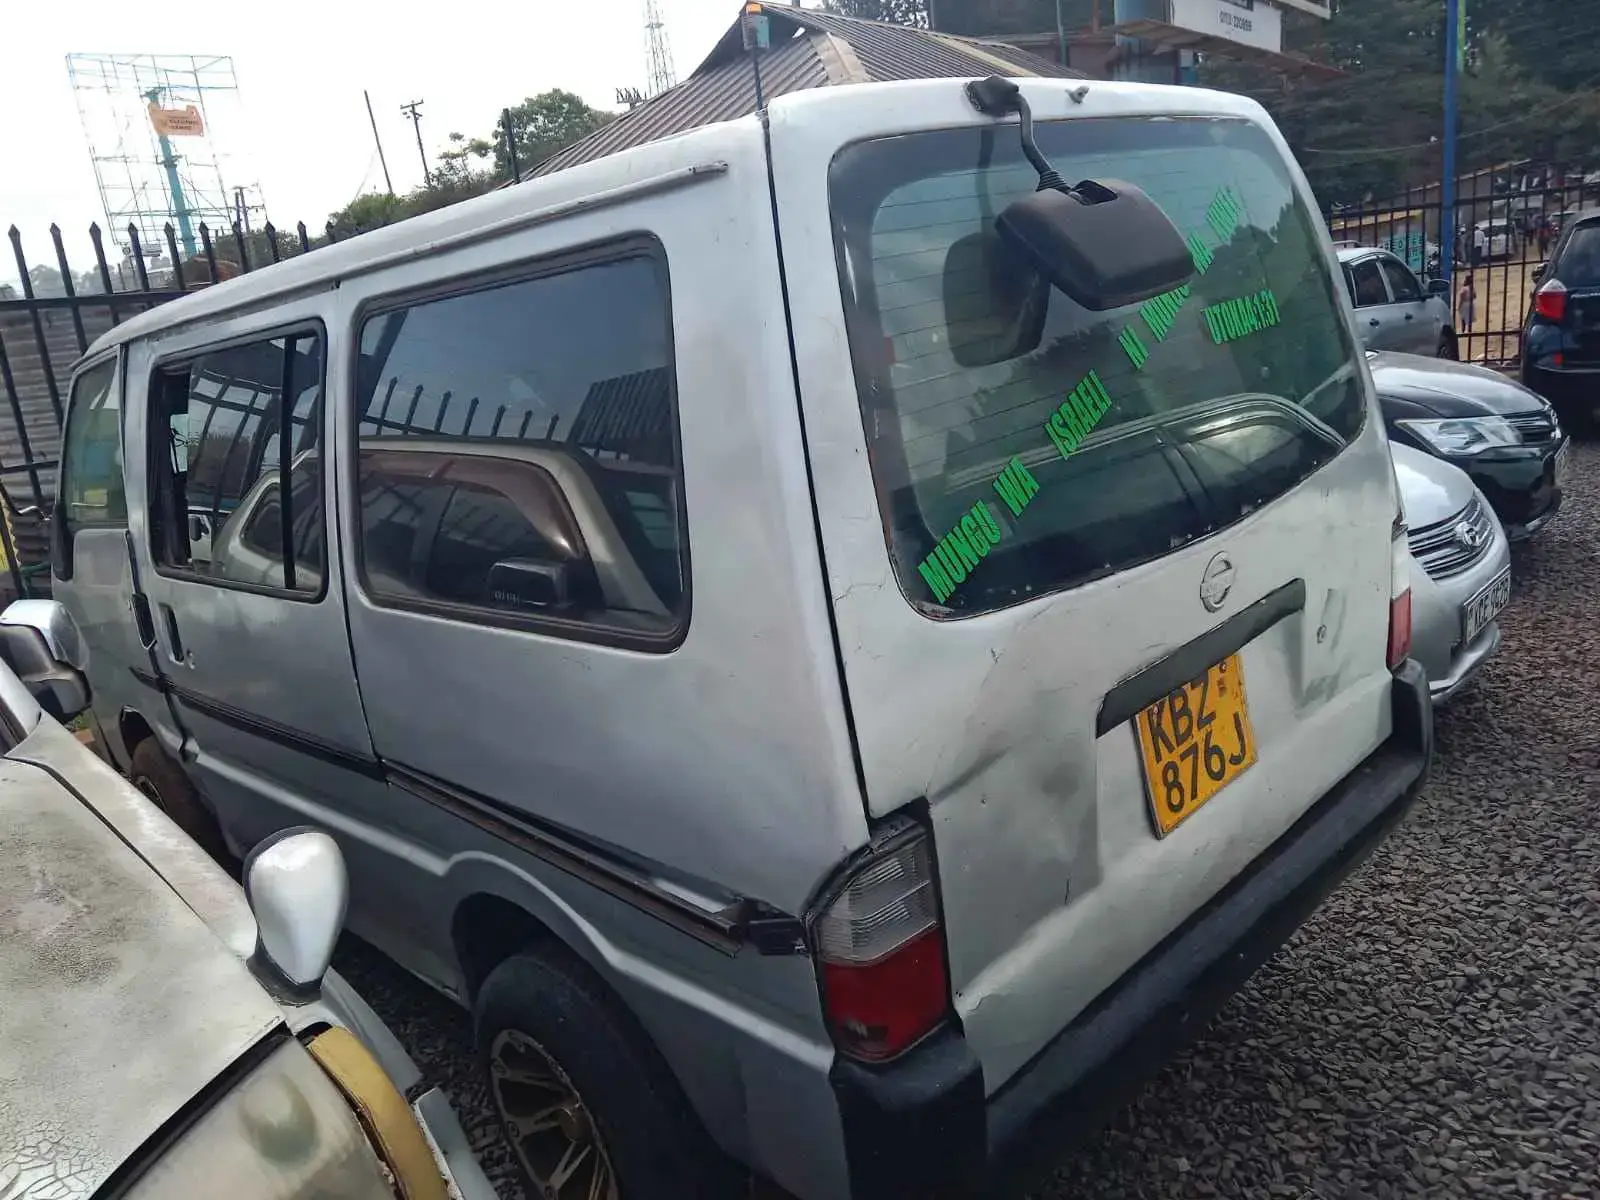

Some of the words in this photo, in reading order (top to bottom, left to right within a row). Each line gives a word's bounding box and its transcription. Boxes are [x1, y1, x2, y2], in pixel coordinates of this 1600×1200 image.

[917, 499, 1001, 605] MUNGU
[992, 456, 1041, 517] WA
[1043, 368, 1113, 461] ISRAELI
[1117, 323, 1150, 370] NI
[1147, 668, 1217, 764] KBZ
[1162, 711, 1247, 813] 876J
